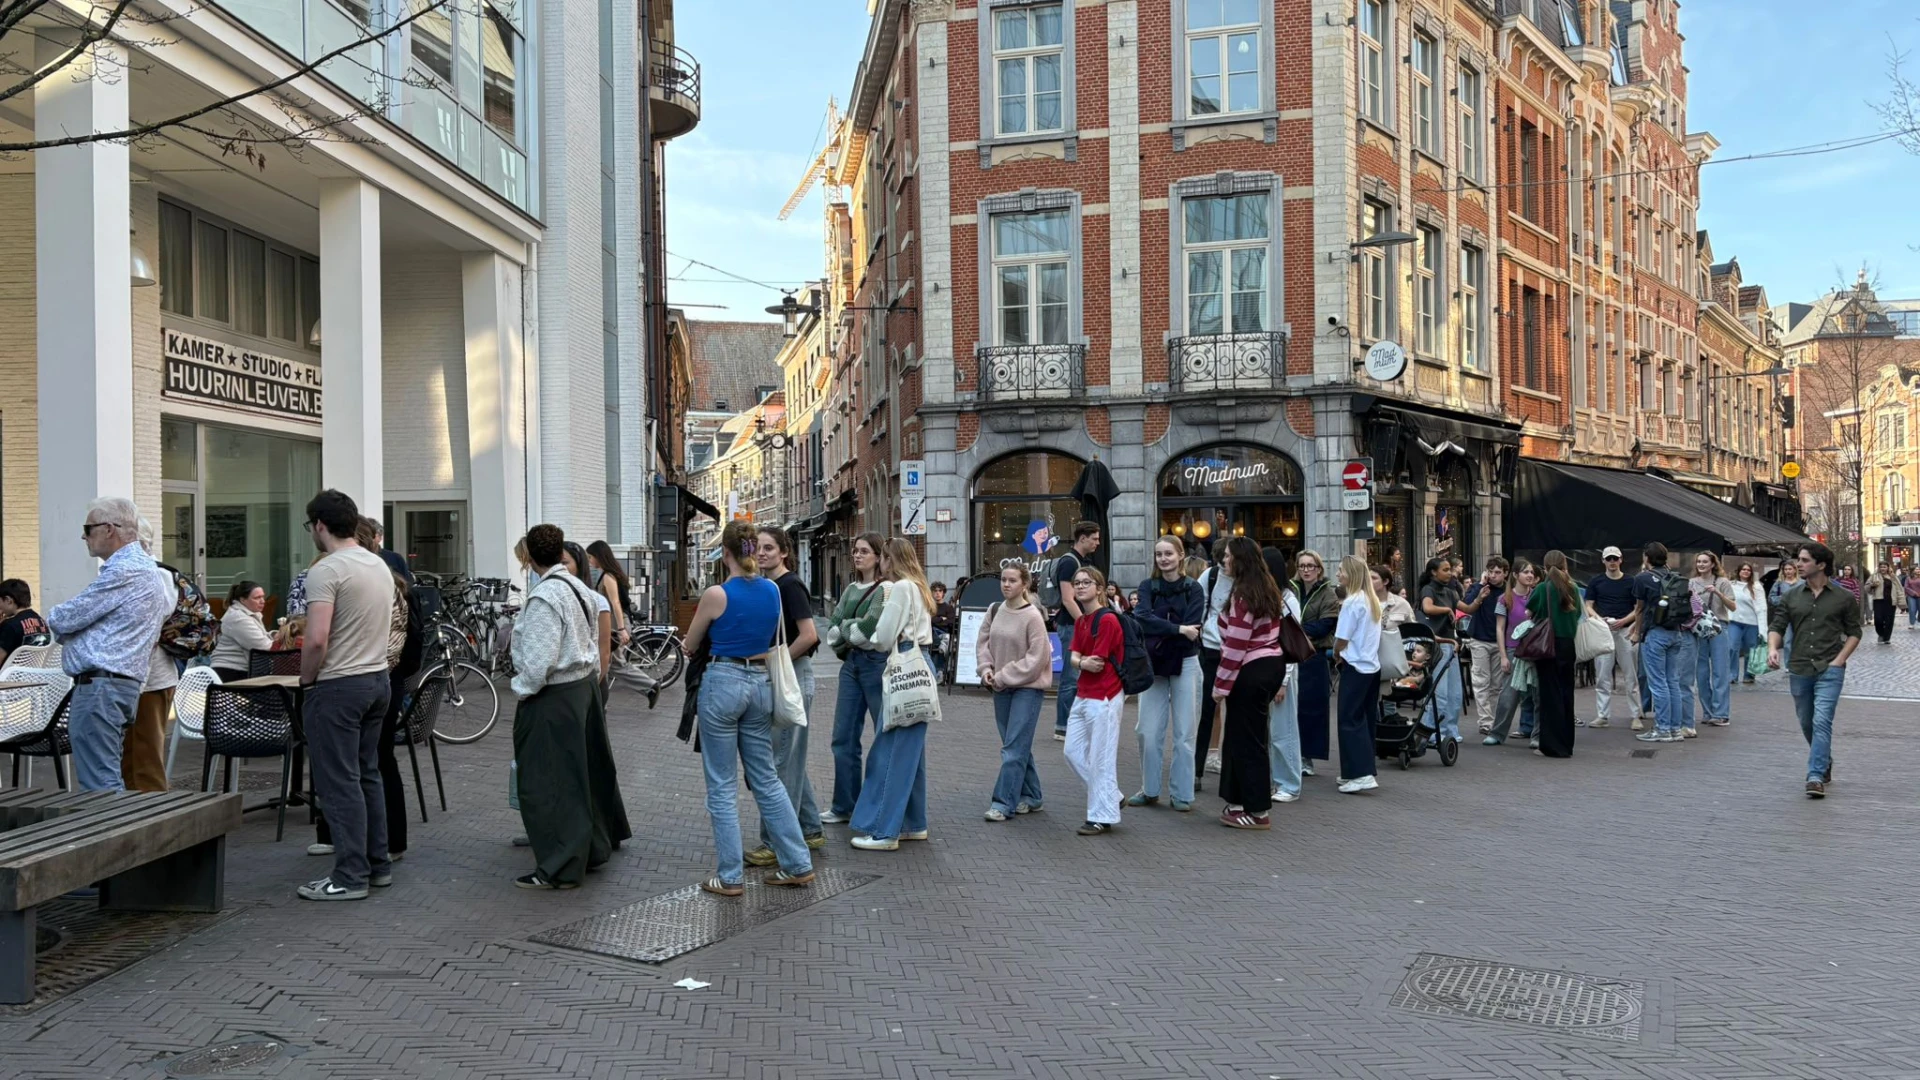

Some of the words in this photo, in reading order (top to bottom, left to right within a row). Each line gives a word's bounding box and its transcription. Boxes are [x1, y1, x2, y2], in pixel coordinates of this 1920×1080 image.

[169, 333, 224, 365] KAMER
[241, 352, 292, 380] STUDIO
[306, 368, 322, 387] FL
[1371, 346, 1397, 361] Mad
[1184, 462, 1270, 487] Madmum
